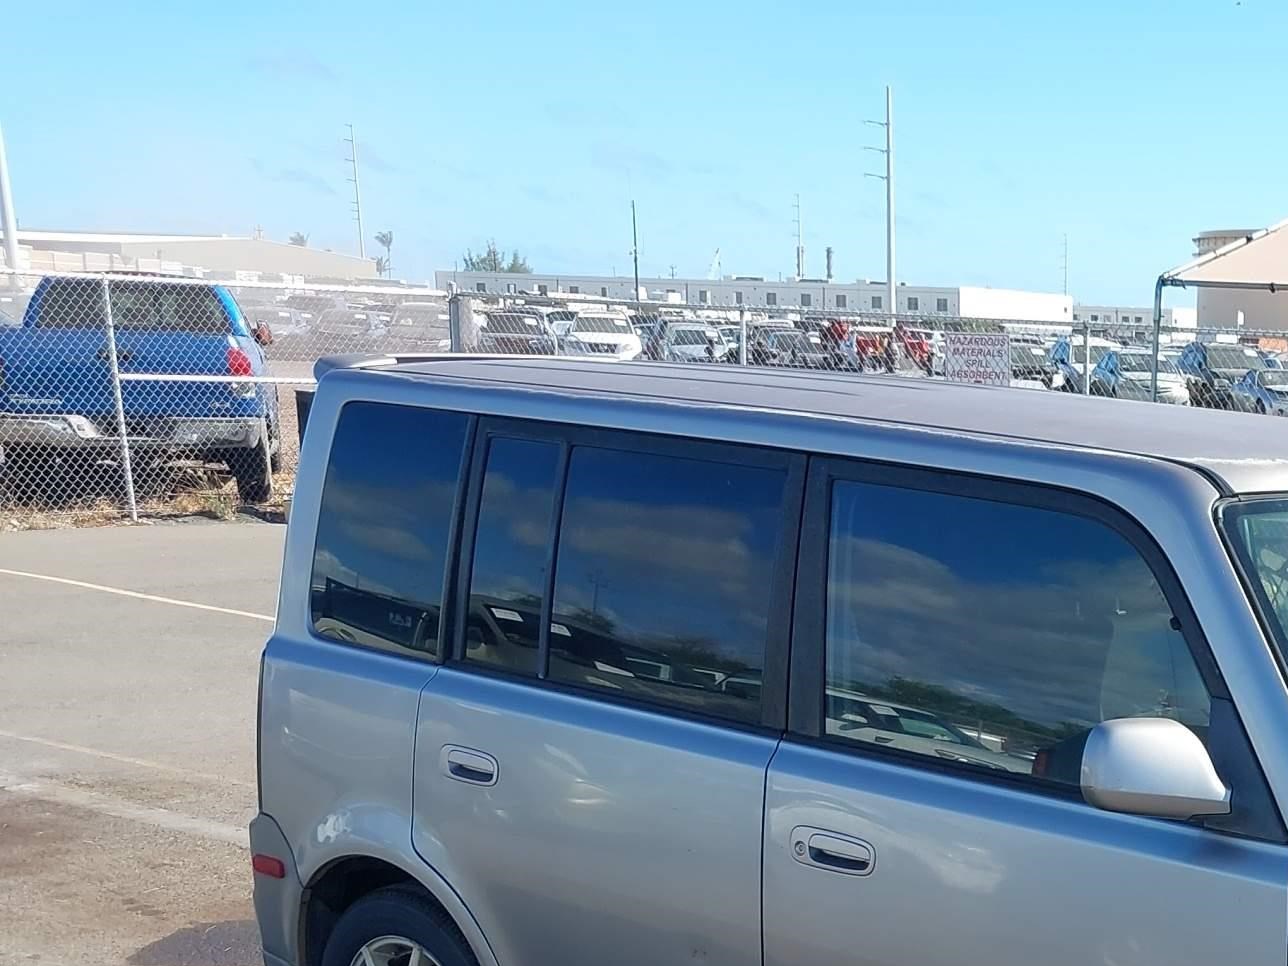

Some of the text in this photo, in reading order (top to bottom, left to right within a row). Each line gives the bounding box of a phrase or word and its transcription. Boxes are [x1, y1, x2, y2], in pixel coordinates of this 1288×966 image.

[949, 336, 1006, 347] HAZARDOUS
[952, 347, 1004, 358] MATERIALS
[966, 359, 991, 369] SPILL
[951, 370, 1006, 381] ABSORBENT
